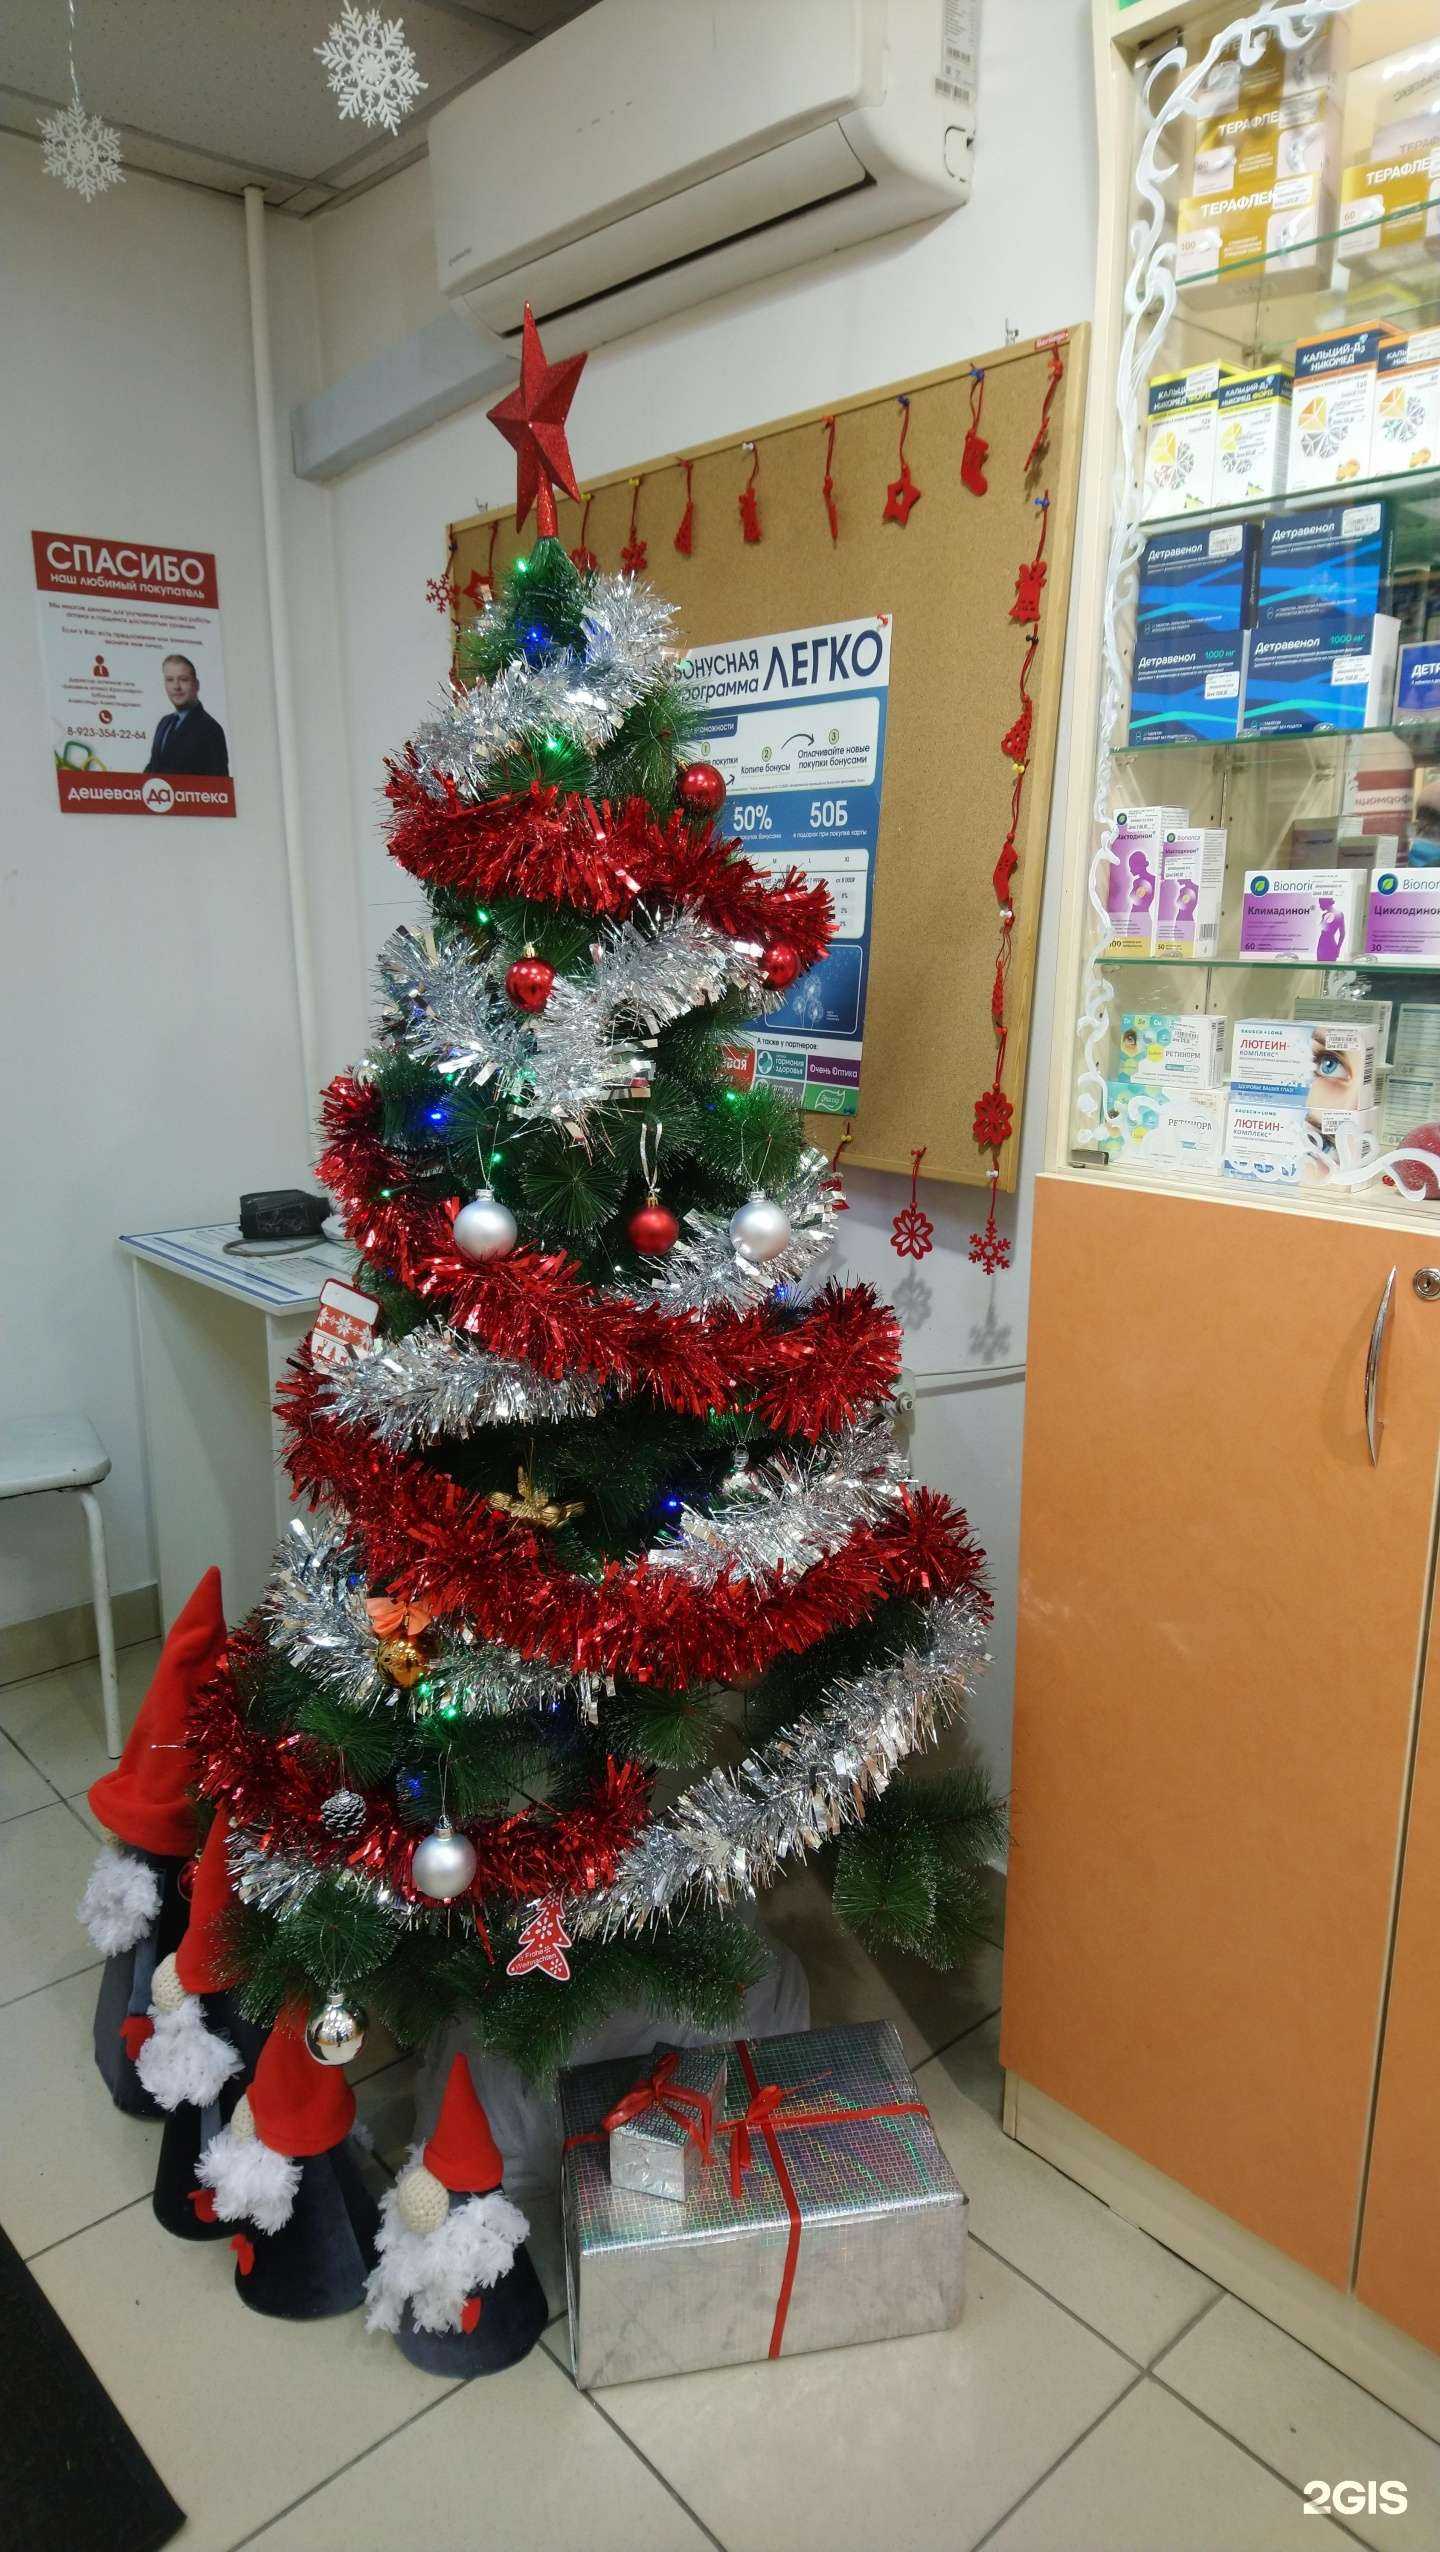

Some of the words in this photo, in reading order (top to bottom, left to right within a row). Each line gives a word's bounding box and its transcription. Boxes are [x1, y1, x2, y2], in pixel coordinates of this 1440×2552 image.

[1218, 111, 1280, 137] ТЕРАФЛЕ
[1366, 157, 1432, 186] ТЕРАФЛЕ
[1200, 189, 1278, 217] ТЕРАФЛЕК
[1271, 522, 1335, 542] Детравенол
[1148, 544, 1203, 562] Детравенол
[46, 541, 205, 586] СПАСИБО
[50, 573, 77, 585] наш
[80, 576, 138, 592] любимый
[140, 584, 205, 600] покупатель
[1255, 637, 1321, 656] Детравенол
[1329, 634, 1351, 645] 1000
[763, 629, 883, 692] ЛЕГКО
[1138, 653, 1196, 669] Детравенол
[1206, 649, 1225, 659] 1000
[680, 677, 759, 704] рограмма
[66, 726, 146, 740] 8-923-354-22-64
[798, 745, 845, 758] Оплачивайте
[846, 744, 870, 754] новые
[740, 765, 764, 776] Копите
[765, 763, 791, 774] бонусы
[799, 759, 828, 770] покупки
[829, 755, 868, 768] бонусами
[175, 790, 229, 804] аптека
[733, 804, 773, 832] 50%
[809, 800, 848, 828] 50Б
[1244, 942, 1256, 951] 60
[1370, 944, 1382, 952] 30
[809, 1064, 831, 1075] Очень
[832, 1067, 858, 1078] Оптика
[1233, 1118, 1284, 1131] ЛЮТЕИН-
